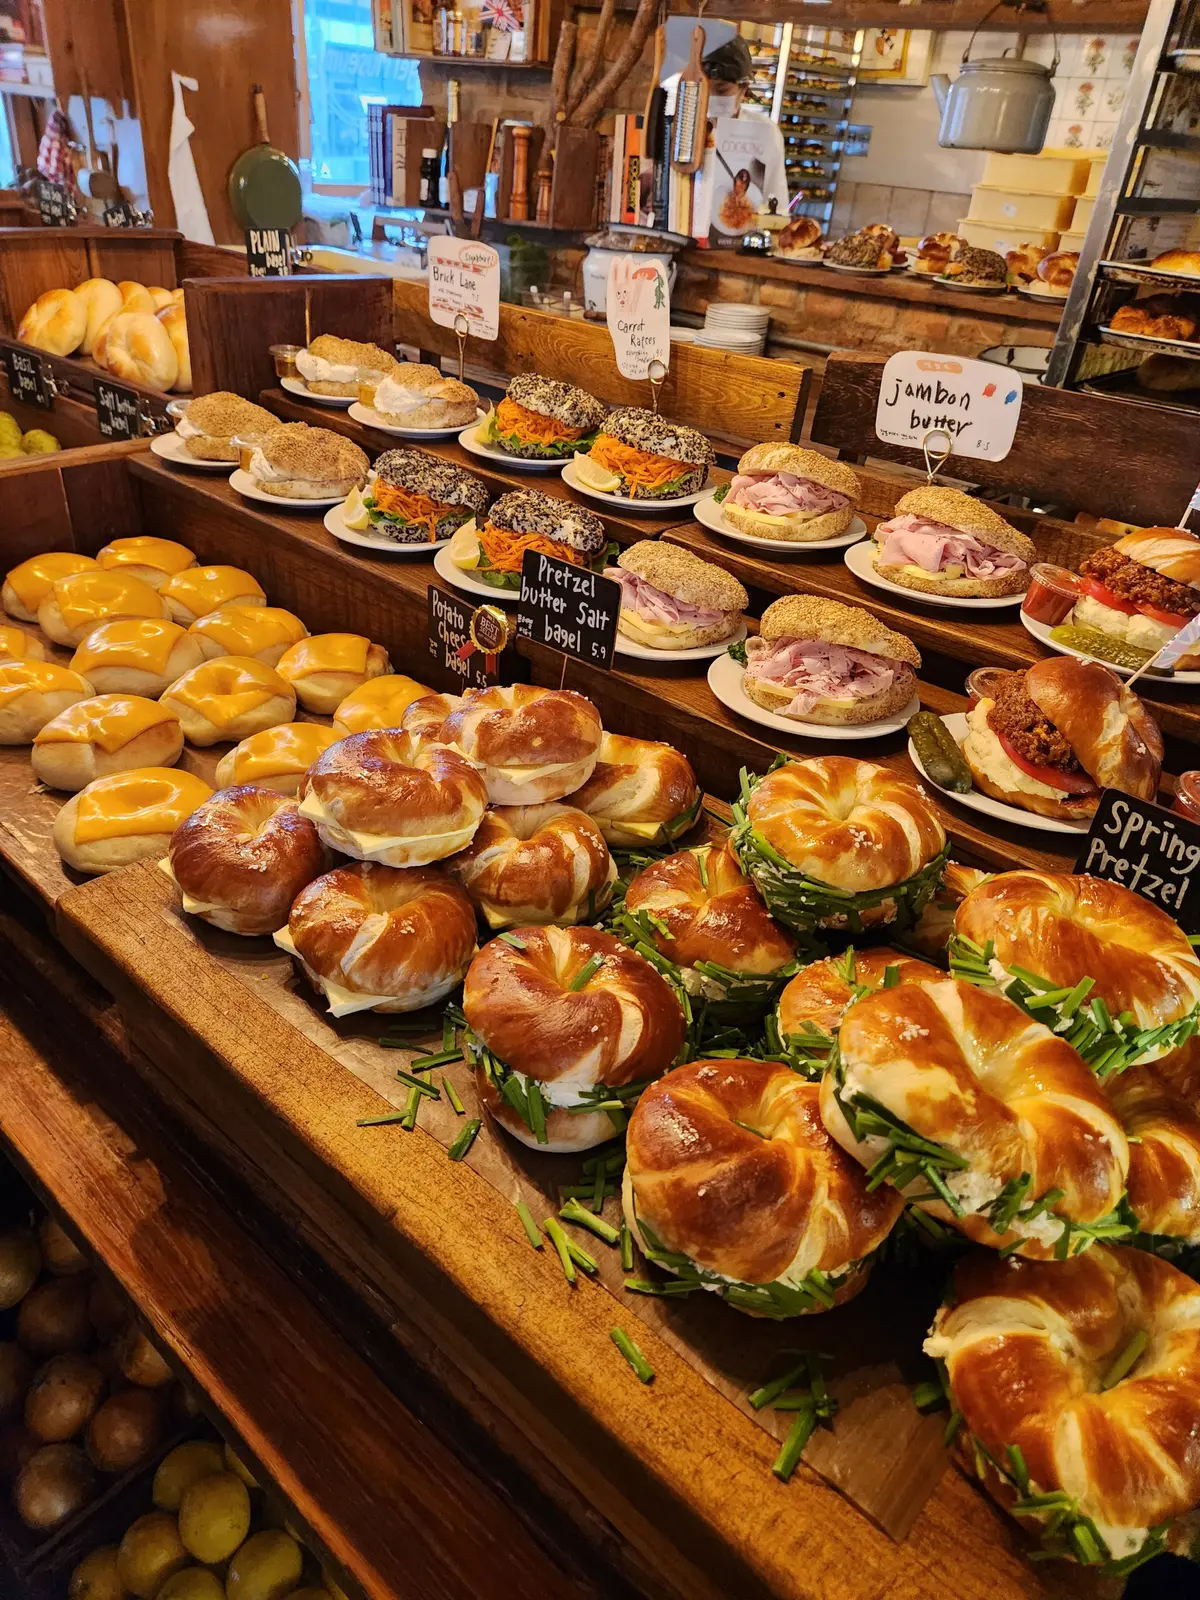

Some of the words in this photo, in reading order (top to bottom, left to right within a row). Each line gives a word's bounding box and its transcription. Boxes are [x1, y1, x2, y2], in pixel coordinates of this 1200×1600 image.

[250, 230, 280, 255] PLAIN
[432, 266, 455, 285] Brick
[459, 272, 477, 291] Lane
[617, 318, 646, 334] Carrot
[99, 386, 115, 410] Salt
[885, 378, 971, 411] jambon
[108, 411, 129, 434] bagel
[910, 409, 973, 437] butter
[538, 555, 595, 598] Pretzel
[432, 590, 464, 630] Potato
[521, 576, 567, 614] butter
[575, 602, 610, 631] Salt
[438, 620, 466, 650] Chees
[478, 625, 497, 642] SELLER
[480, 616, 499, 637] BEST
[544, 614, 581, 652] bagel
[591, 642, 606, 659] 5.9
[445, 648, 470, 679] bagel
[475, 672, 487, 688] 5.5
[1103, 800, 1200, 875] Spring
[1085, 837, 1190, 909] Pretzel
